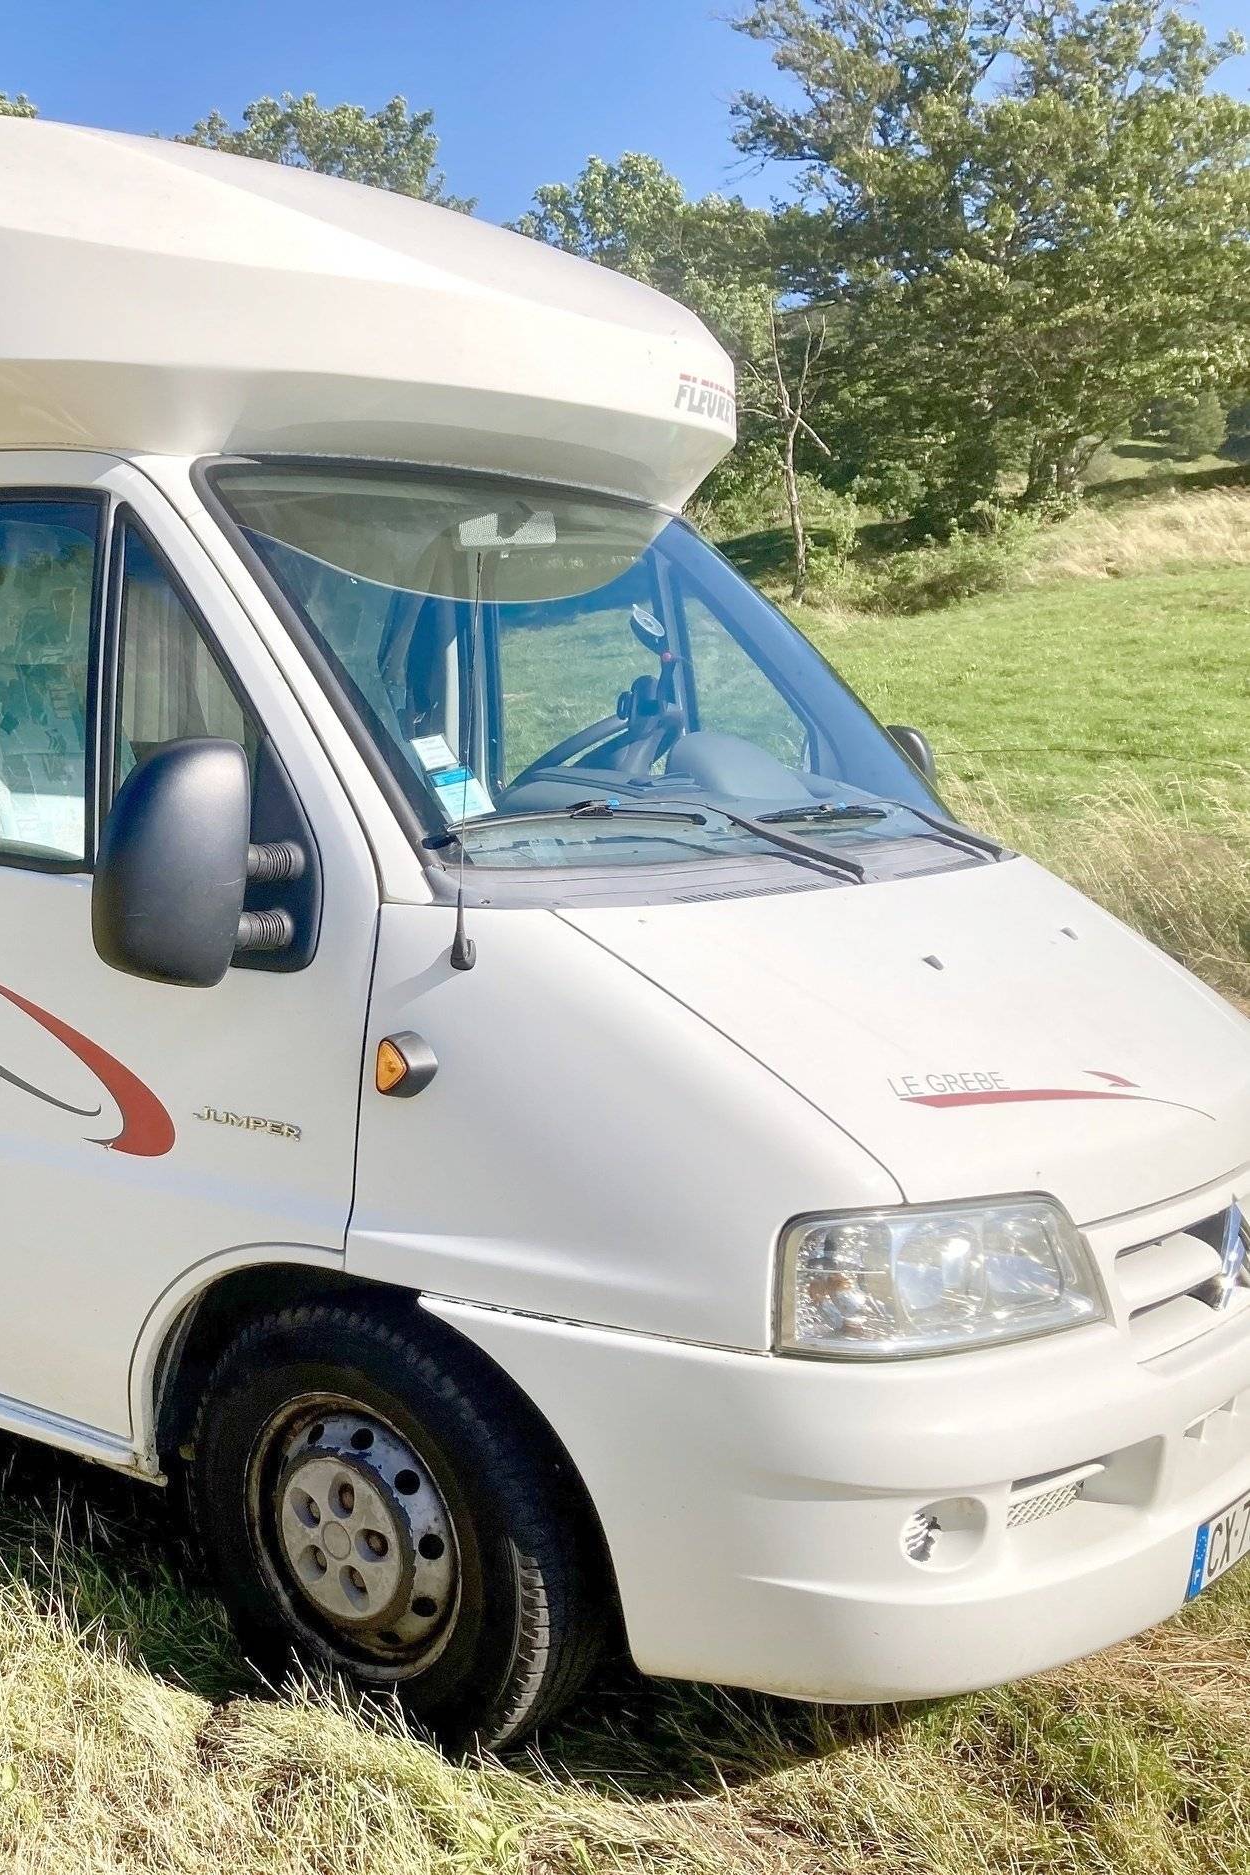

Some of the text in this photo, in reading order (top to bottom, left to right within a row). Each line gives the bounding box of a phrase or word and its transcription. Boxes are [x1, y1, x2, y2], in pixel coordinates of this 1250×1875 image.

[886, 1071, 1011, 1097] LE GREBE
[192, 1105, 302, 1142] JUMPER
